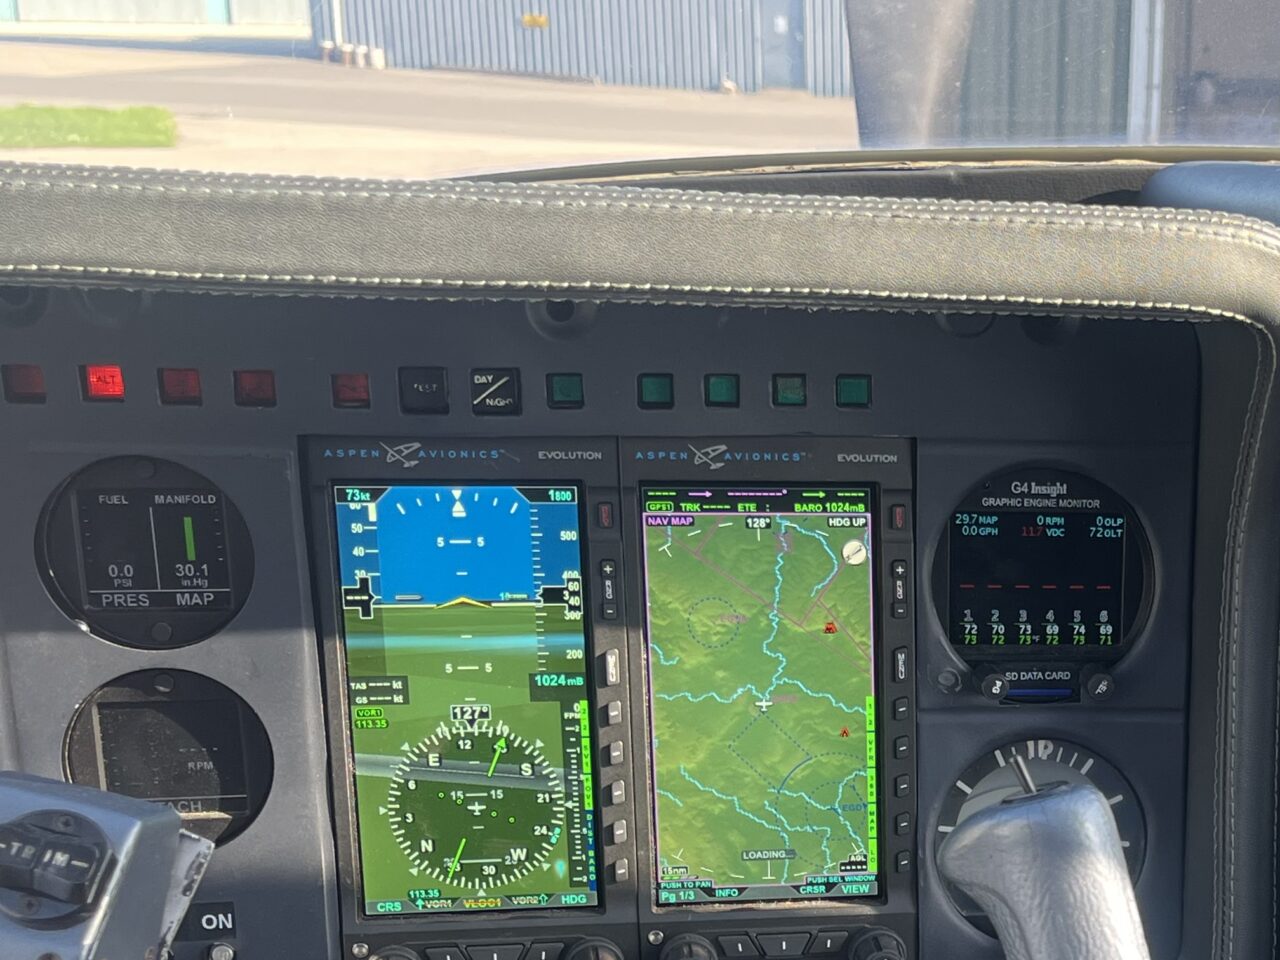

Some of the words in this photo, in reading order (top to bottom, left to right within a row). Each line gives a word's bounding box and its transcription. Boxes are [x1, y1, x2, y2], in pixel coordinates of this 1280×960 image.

[474, 375, 493, 383] DAY
[418, 450, 498, 458] AVIONICS
[538, 451, 602, 460] EVOLUTION
[635, 452, 688, 460] ASPEN
[724, 452, 800, 461] AVIONICS
[837, 453, 897, 463] EVOLUTION
[1011, 482, 1029, 493] G4
[1031, 482, 1067, 497] Insight
[98, 495, 129, 504] FUEL
[154, 495, 216, 504] MANIFOLD
[548, 490, 572, 501] 1800
[680, 503, 700, 511] TRK
[737, 503, 757, 512] ETE
[794, 503, 822, 512] BARO
[982, 498, 1022, 507] GRAPHIC
[1024, 499, 1057, 507] ENGINE
[1059, 499, 1100, 508] MONITOR
[647, 516, 671, 525] NAV
[673, 516, 693, 525] MAP
[828, 518, 850, 527] HDG
[955, 514, 978, 524] 29.7
[560, 531, 577, 541] 500
[979, 527, 998, 536] GPH
[108, 564, 134, 577] 0.0
[175, 563, 209, 577] 30.1
[102, 594, 149, 606] PRES
[176, 593, 214, 606] MAP
[566, 650, 582, 659] 200
[1005, 672, 1019, 681] SD
[1020, 672, 1044, 680] DATA
[1045, 671, 1071, 680] CARD
[356, 720, 387, 728] 113.35
[458, 740, 472, 750] 12
[428, 754, 440, 766] E
[521, 764, 533, 776] S
[421, 840, 433, 851] N
[510, 848, 527, 861] W
[715, 888, 739, 897] INFO
[800, 885, 826, 894] CRSR
[842, 884, 869, 894] VIEW
[661, 892, 676, 902] Pg
[680, 890, 694, 899] 1/3
[377, 902, 401, 912] CRS
[561, 894, 587, 904] HDG
[202, 913, 233, 930] ON
